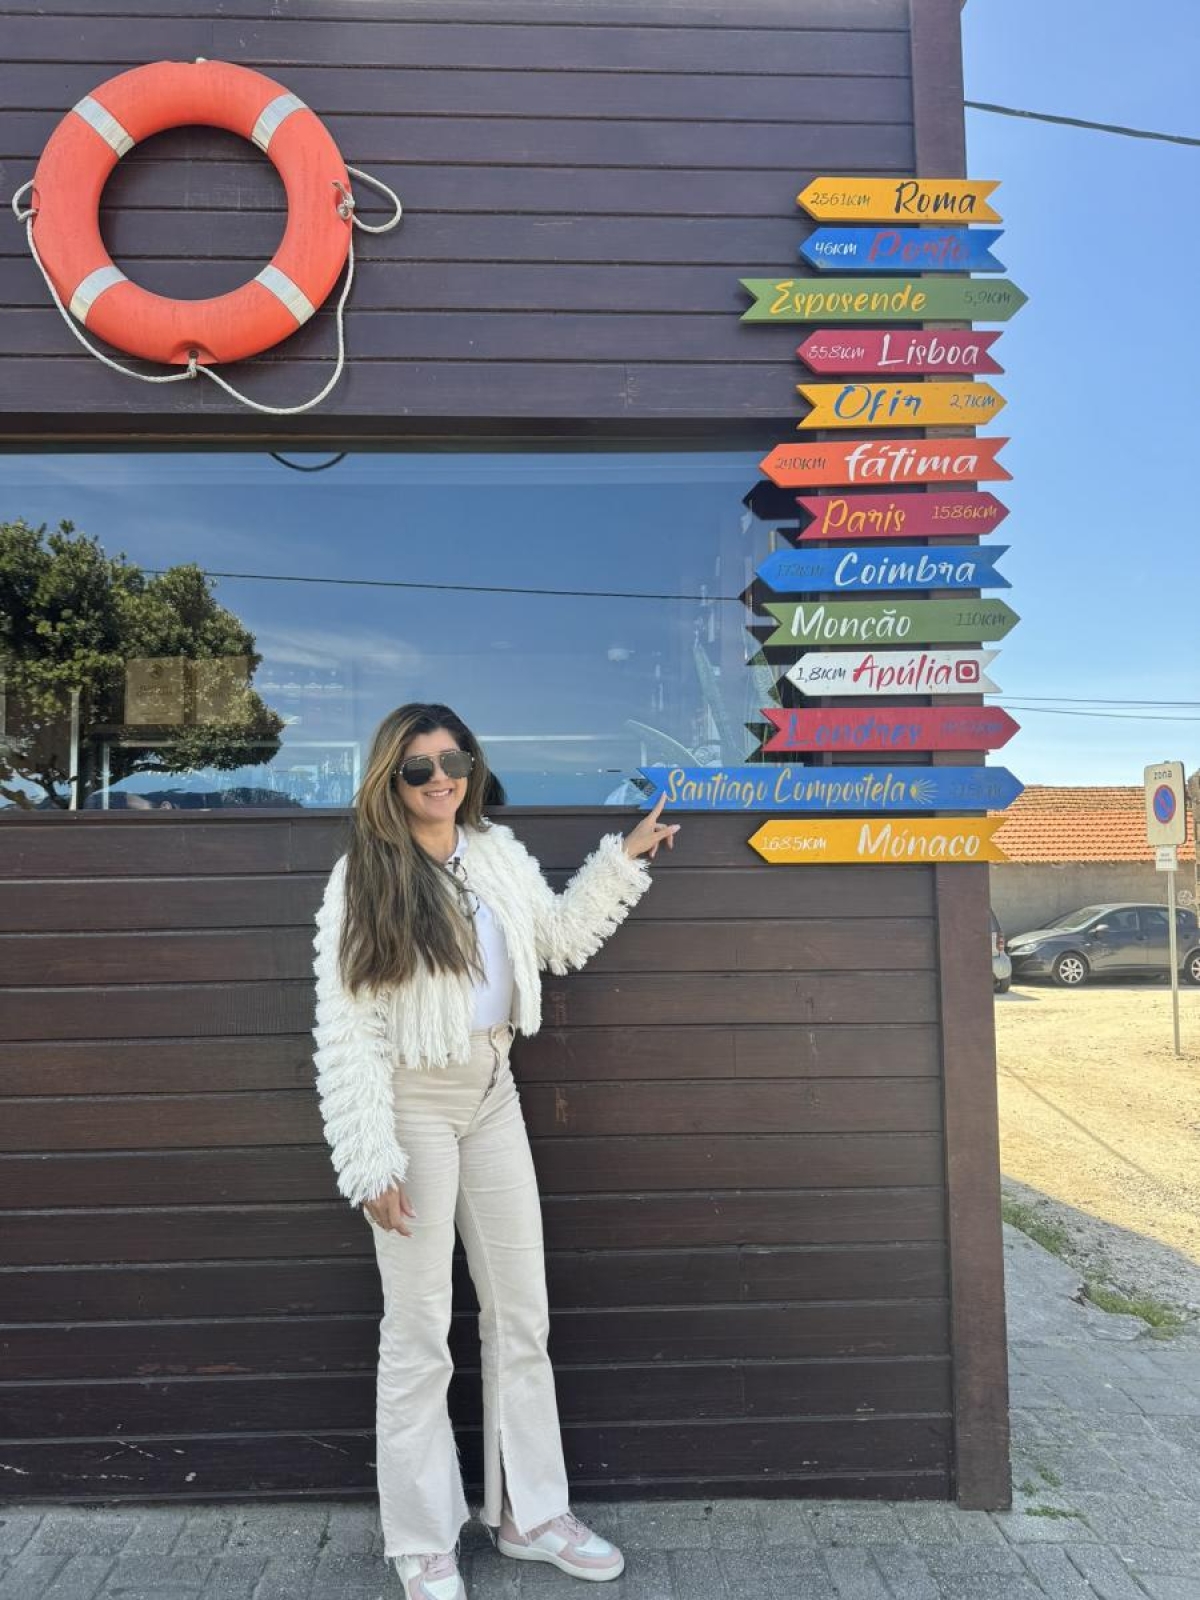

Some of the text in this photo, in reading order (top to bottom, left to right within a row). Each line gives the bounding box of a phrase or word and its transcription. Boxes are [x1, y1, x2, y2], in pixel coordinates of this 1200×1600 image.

[894, 181, 977, 214] Roma
[814, 231, 970, 264] 46KM Porto
[769, 280, 927, 318] Esposende
[877, 333, 979, 367] Lisboa
[949, 393, 996, 410] 2,7KM
[822, 499, 998, 534] Paris 1586KM
[834, 551, 976, 587] Coimbra
[791, 605, 912, 641] Monção
[795, 653, 953, 692] 1,8KM Apúlia
[784, 711, 923, 748] Londres
[667, 767, 768, 808] Santiago
[774, 767, 905, 808] Compostela
[1153, 769, 1173, 780] zona
[857, 822, 980, 857] Mónaco
